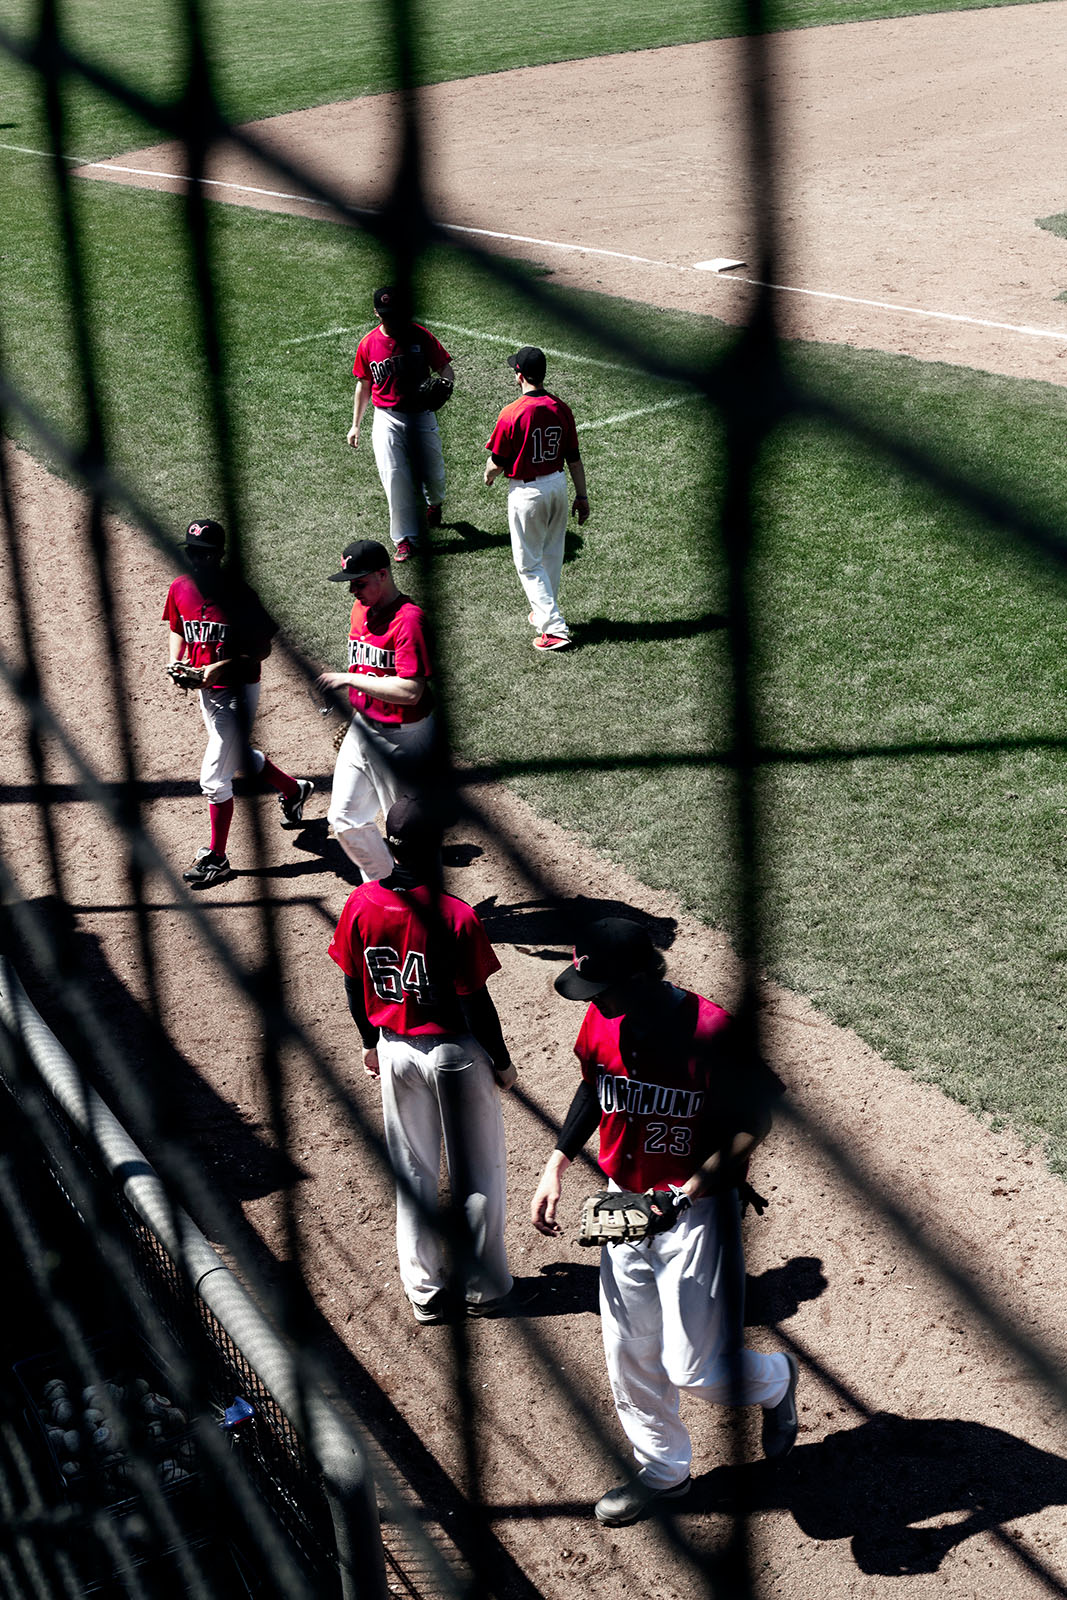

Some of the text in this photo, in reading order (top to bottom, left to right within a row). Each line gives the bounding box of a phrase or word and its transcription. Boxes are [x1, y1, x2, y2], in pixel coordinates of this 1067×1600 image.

[531, 425, 563, 464] 13
[363, 945, 437, 1006] 64
[644, 1121, 693, 1157] 23
